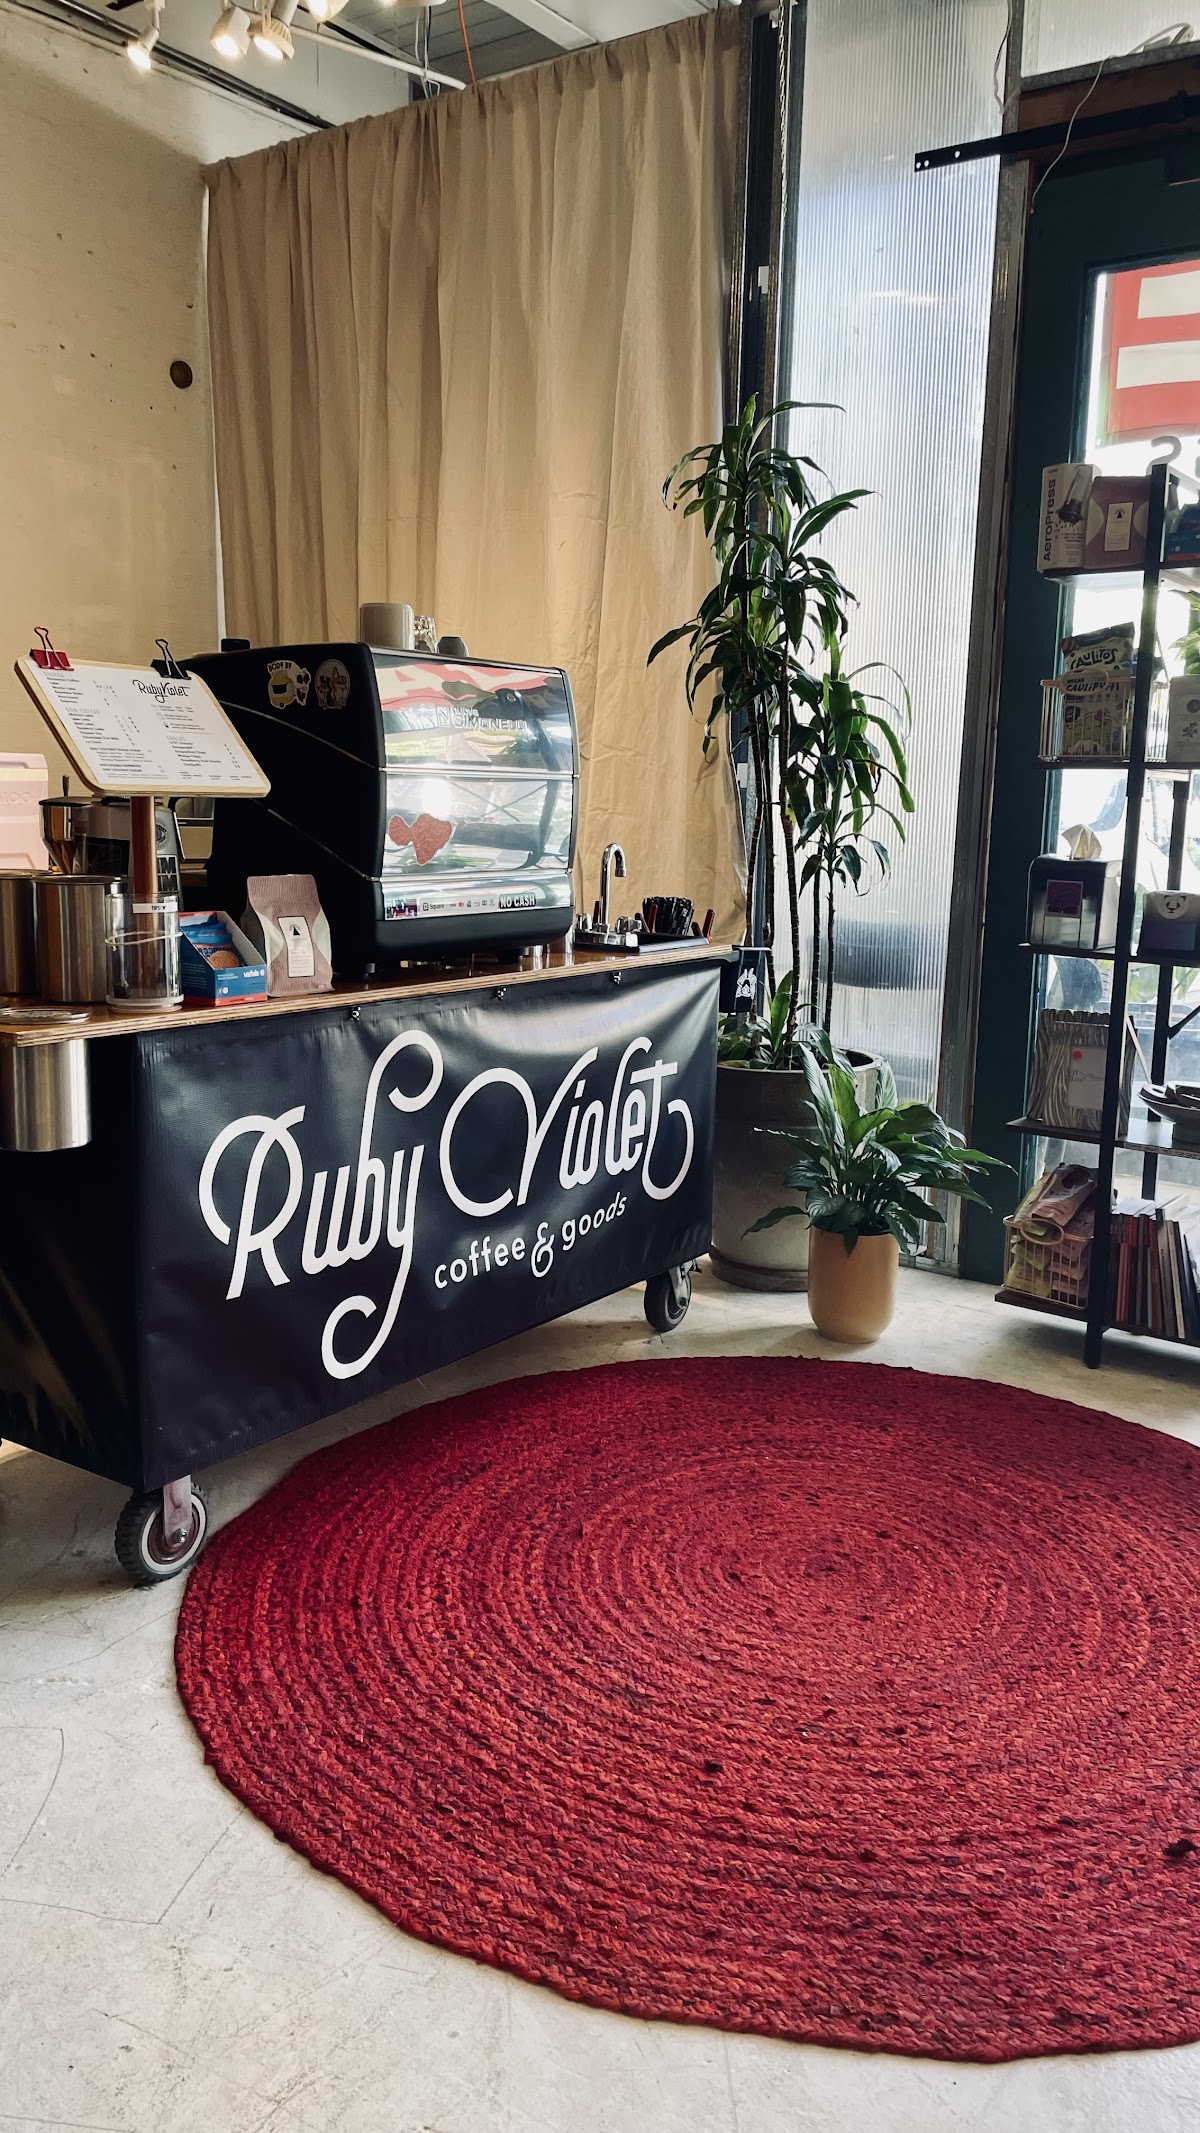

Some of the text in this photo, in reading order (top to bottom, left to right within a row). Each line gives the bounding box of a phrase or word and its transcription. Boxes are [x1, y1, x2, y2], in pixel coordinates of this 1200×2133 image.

[1043, 479, 1056, 561] AeroPress
[132, 679, 168, 703] Ruby
[163, 682, 191, 697] Violet
[429, 903, 445, 911] Square
[500, 896, 512, 908] NO
[517, 895, 535, 907] CASH
[199, 1030, 694, 1379] Ruby Violet
[434, 1192, 627, 1289] coffee & goods
